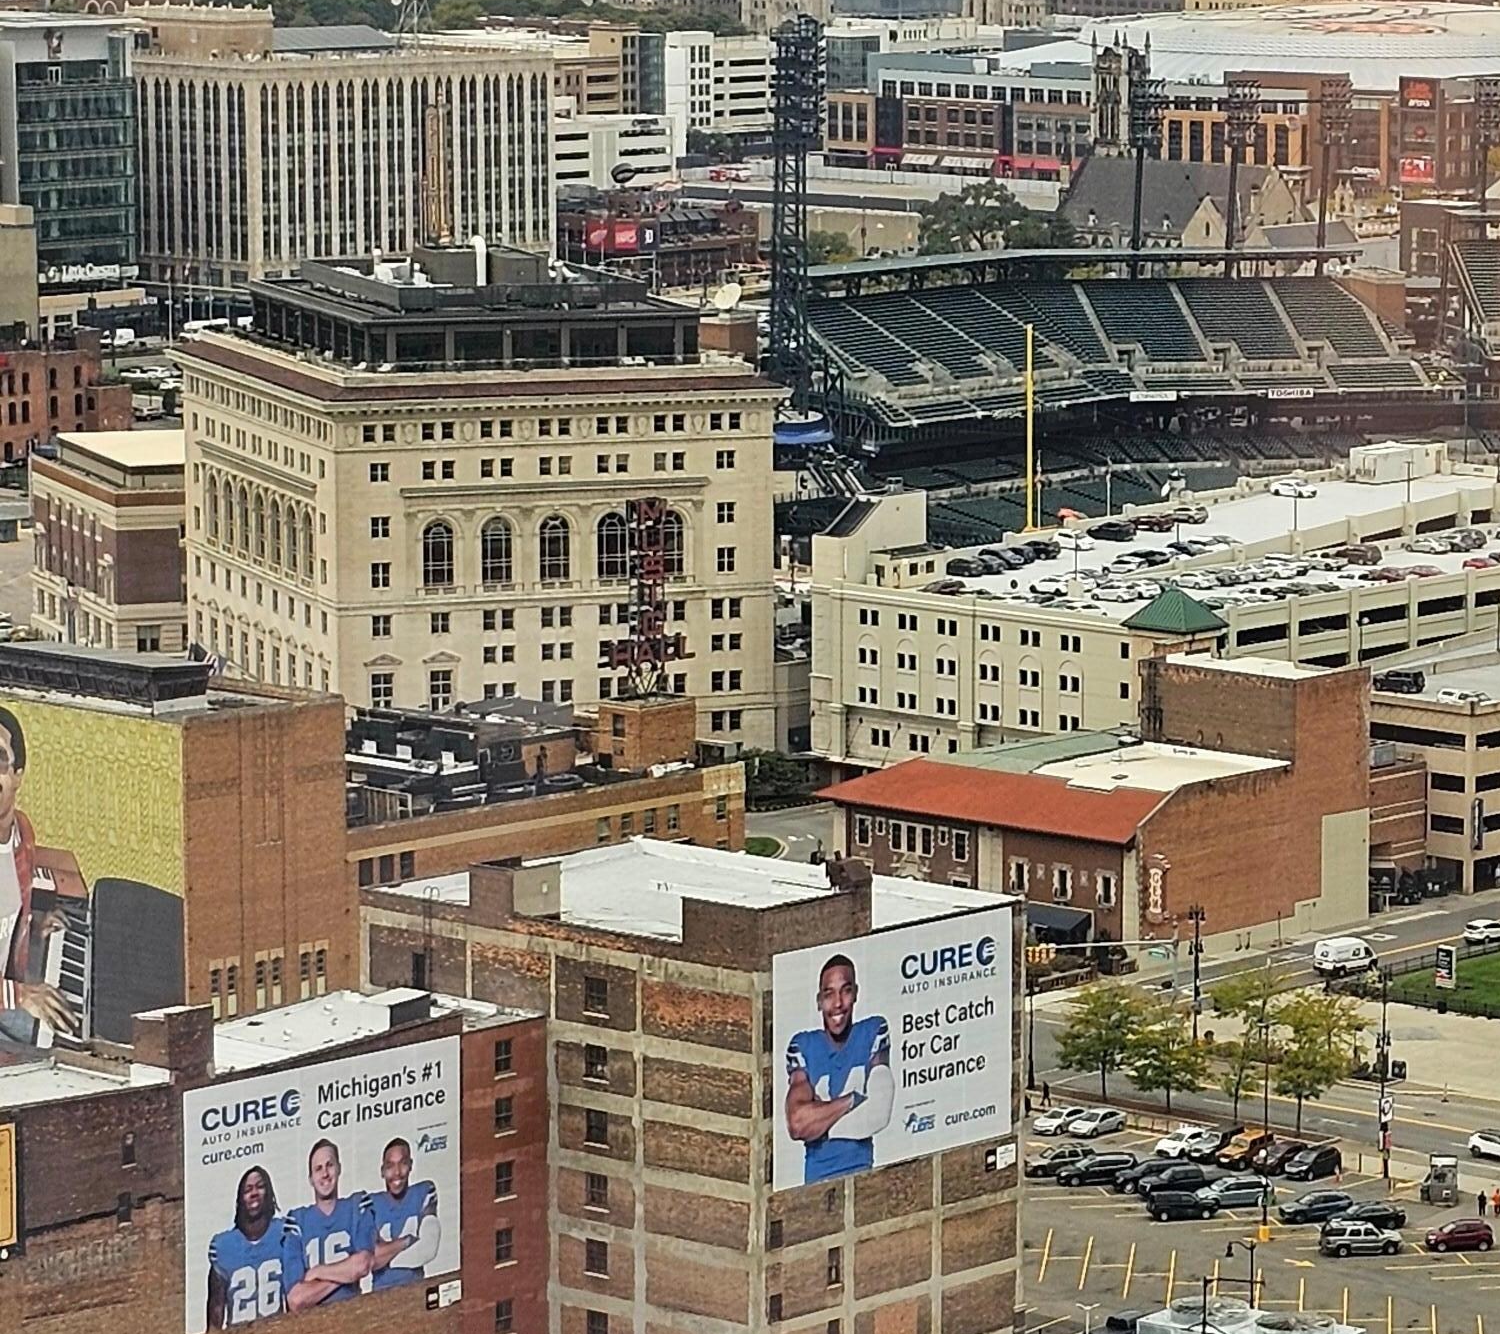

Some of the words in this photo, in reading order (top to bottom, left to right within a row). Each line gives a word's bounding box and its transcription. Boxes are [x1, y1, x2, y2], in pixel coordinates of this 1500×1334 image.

[611, 634, 696, 670] HALL
[901, 942, 973, 981] CURE
[901, 982, 929, 996] AUTO
[934, 966, 997, 989] INSURANCE
[902, 1010, 940, 1035] Best
[945, 996, 994, 1025] Catch
[901, 1039, 925, 1062] for
[930, 1032, 960, 1055] Car
[317, 1064, 416, 1105] Michigan's
[421, 1061, 443, 1083] #1
[902, 1054, 986, 1089] Insurance
[201, 1095, 277, 1132] CURE
[317, 1107, 351, 1131] Car
[355, 1088, 446, 1123] Insurance
[944, 1104, 996, 1127] cure.com
[201, 1132, 232, 1147] AUTO
[236, 1116, 302, 1141] INSURANCE
[201, 1141, 264, 1166] cure.com
[231, 1258, 283, 1326] 26
